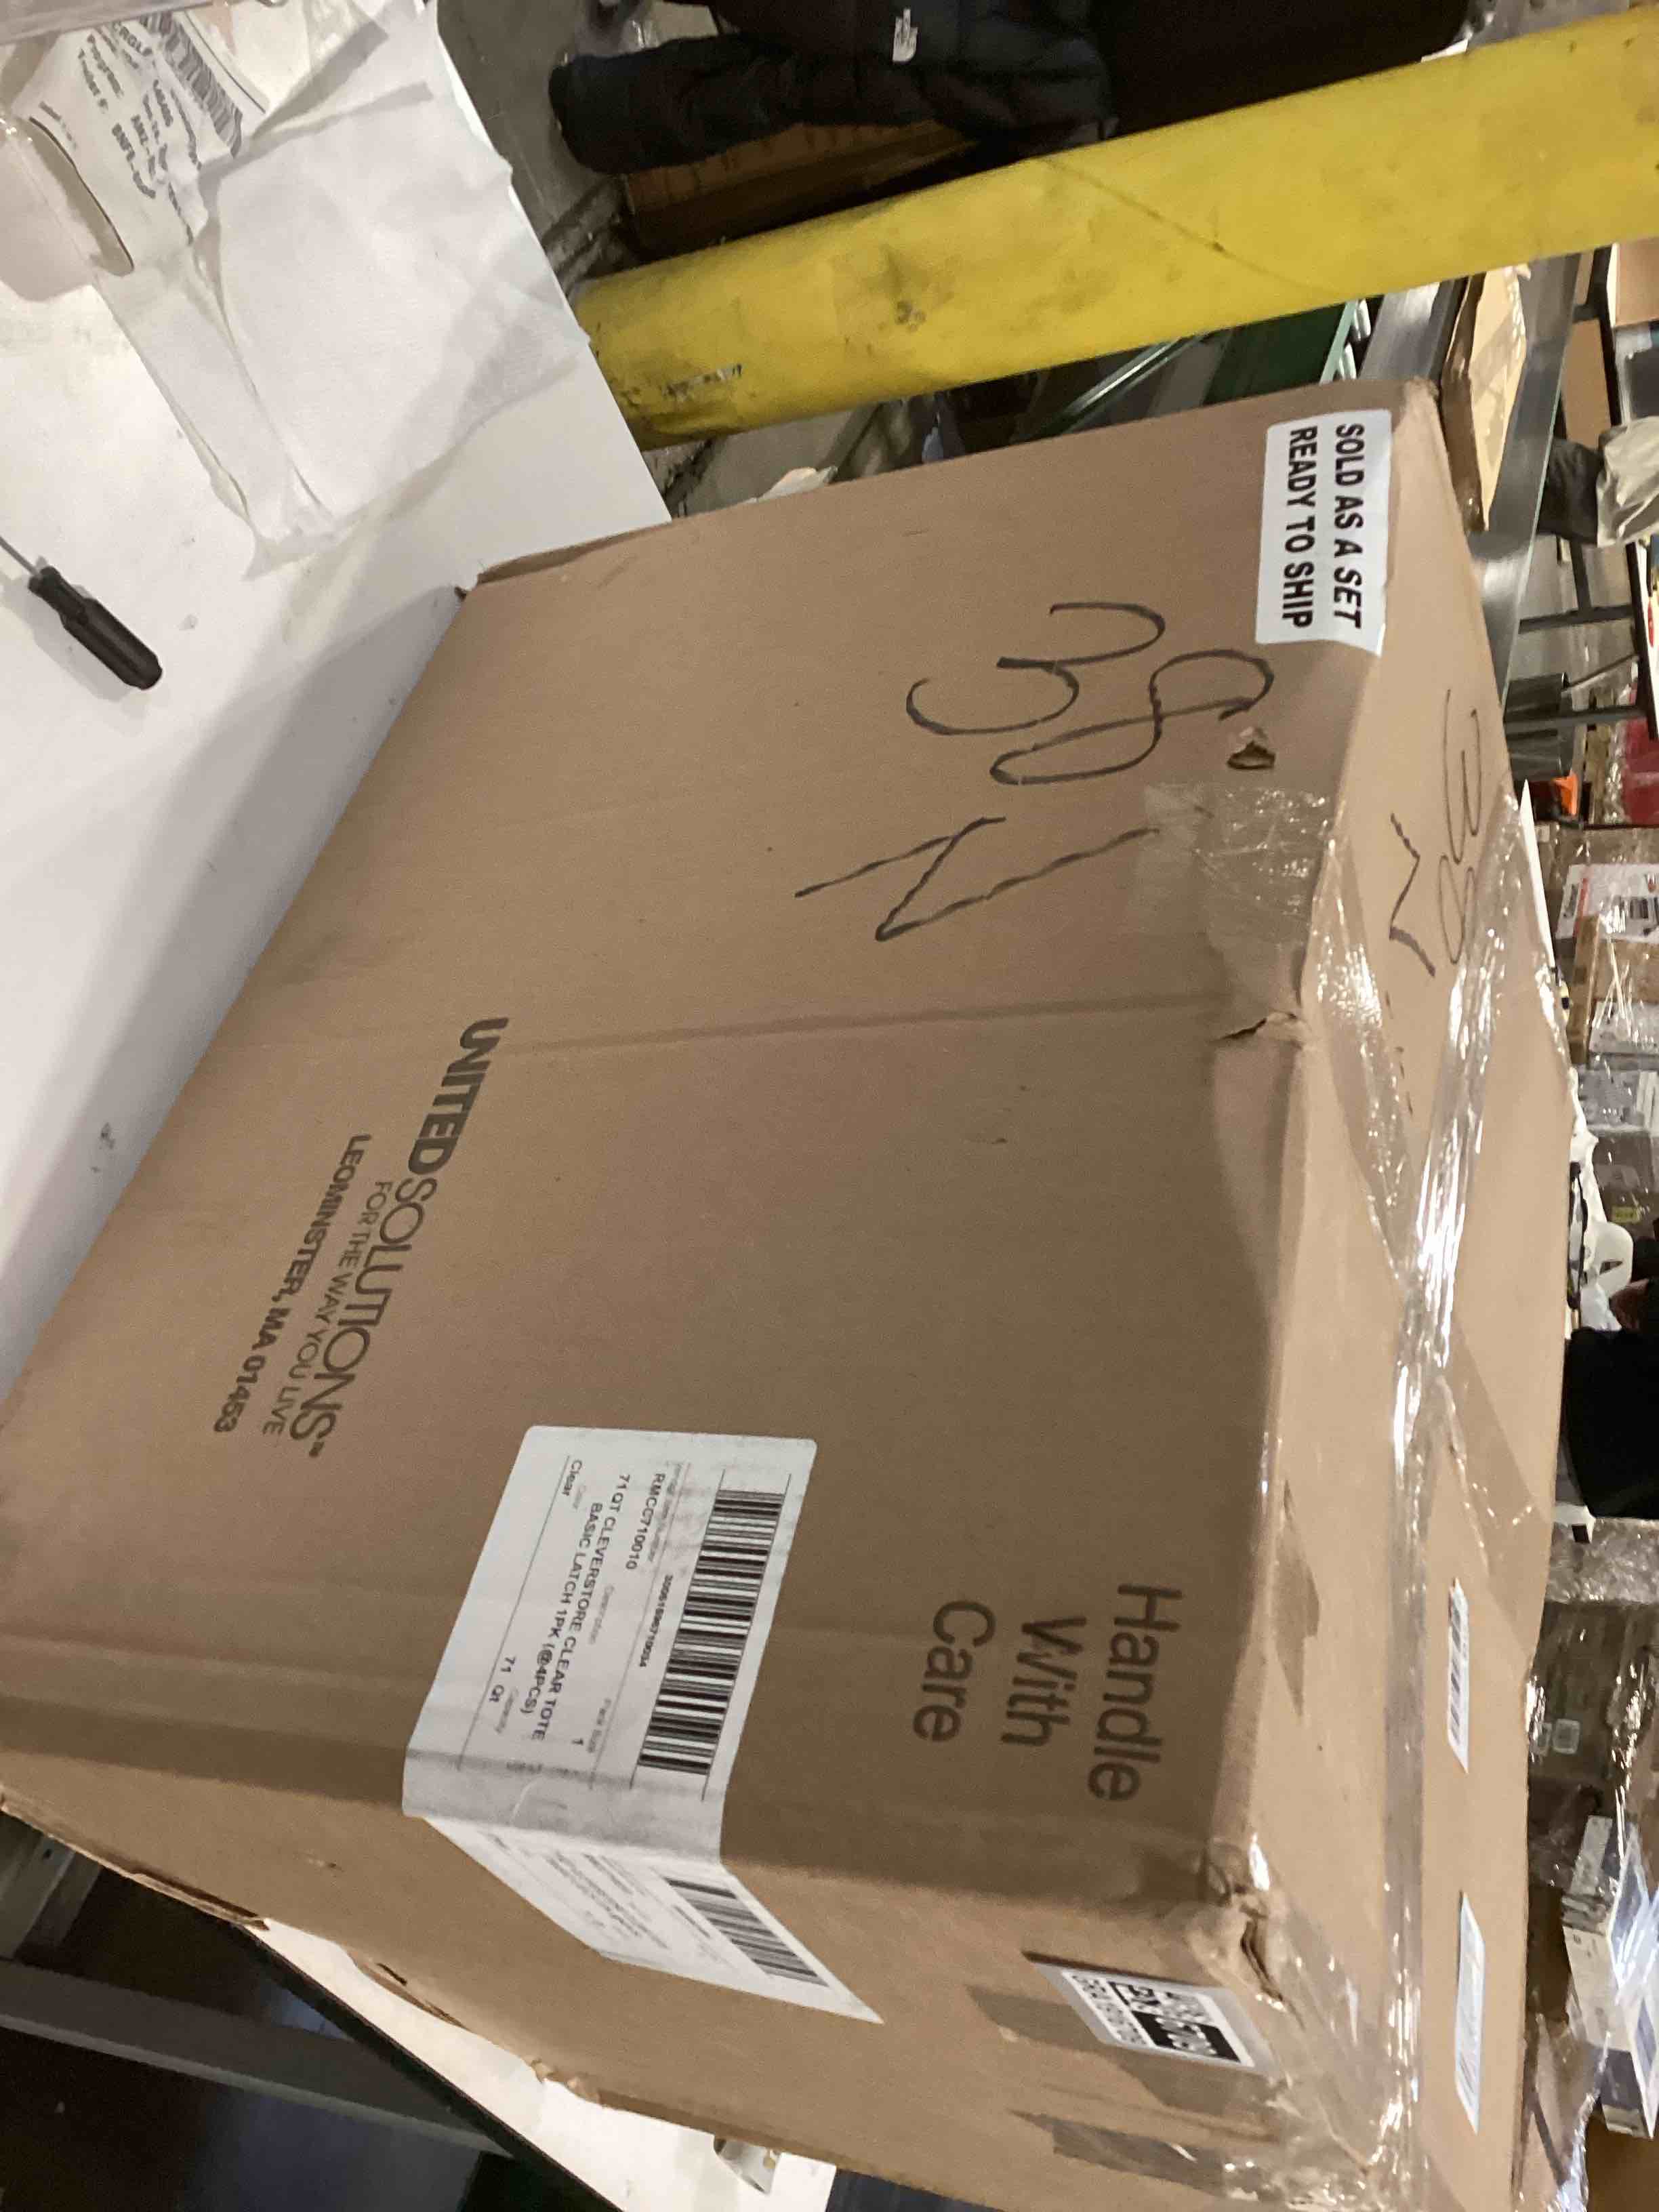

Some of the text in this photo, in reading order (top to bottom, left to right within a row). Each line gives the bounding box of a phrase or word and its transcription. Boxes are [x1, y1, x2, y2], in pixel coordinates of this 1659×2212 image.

[1282, 426, 1318, 629] READY TO SHIP
[1334, 423, 1365, 629] SOLD AS A SET
[251, 1308, 291, 1351] MA
[262, 1181, 393, 1435] FOR THE WAY YOU LIVE
[213, 1355, 266, 1432] 01453
[560, 1460, 583, 1496] Clear
[577, 1502, 605, 1548] BASIC
[623, 1473, 666, 1570] RMCC710010
[558, 1553, 588, 1604] LATCH
[567, 1517, 617, 1631] CLEVERSTORE
[546, 1608, 569, 1638] 1PK
[499, 1656, 516, 1673] 71
[546, 1635, 578, 1694] CLEAR
[913, 1600, 996, 1742] Care
[1000, 1616, 1087, 1746] With
[1088, 1584, 1183, 1801] Handle
[530, 1700, 556, 1742] TOTE
[571, 1737, 585, 1746] 1
